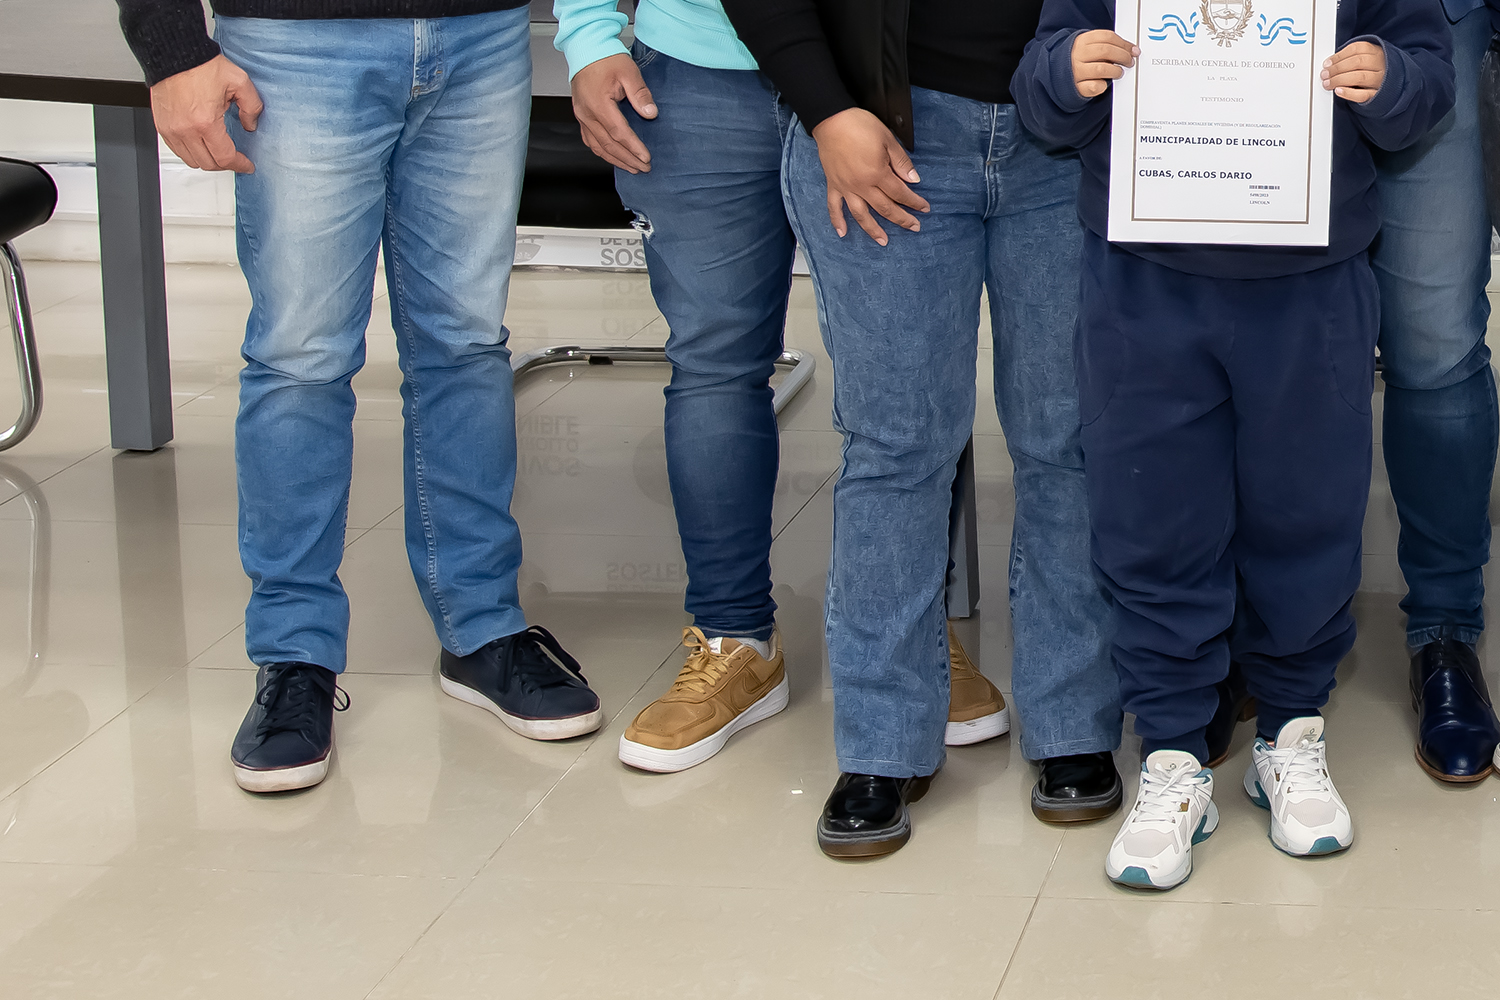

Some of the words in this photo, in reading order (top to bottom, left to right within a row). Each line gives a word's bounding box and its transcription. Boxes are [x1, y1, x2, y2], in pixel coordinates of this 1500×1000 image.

[1201, 60, 1239, 68] GENERAL
[1253, 61, 1295, 69] GOBIERNO
[1140, 136, 1222, 145] MUNICIPALIDAD
[1139, 170, 1174, 179] CUBAS,
[1178, 170, 1216, 179] CARLOS
